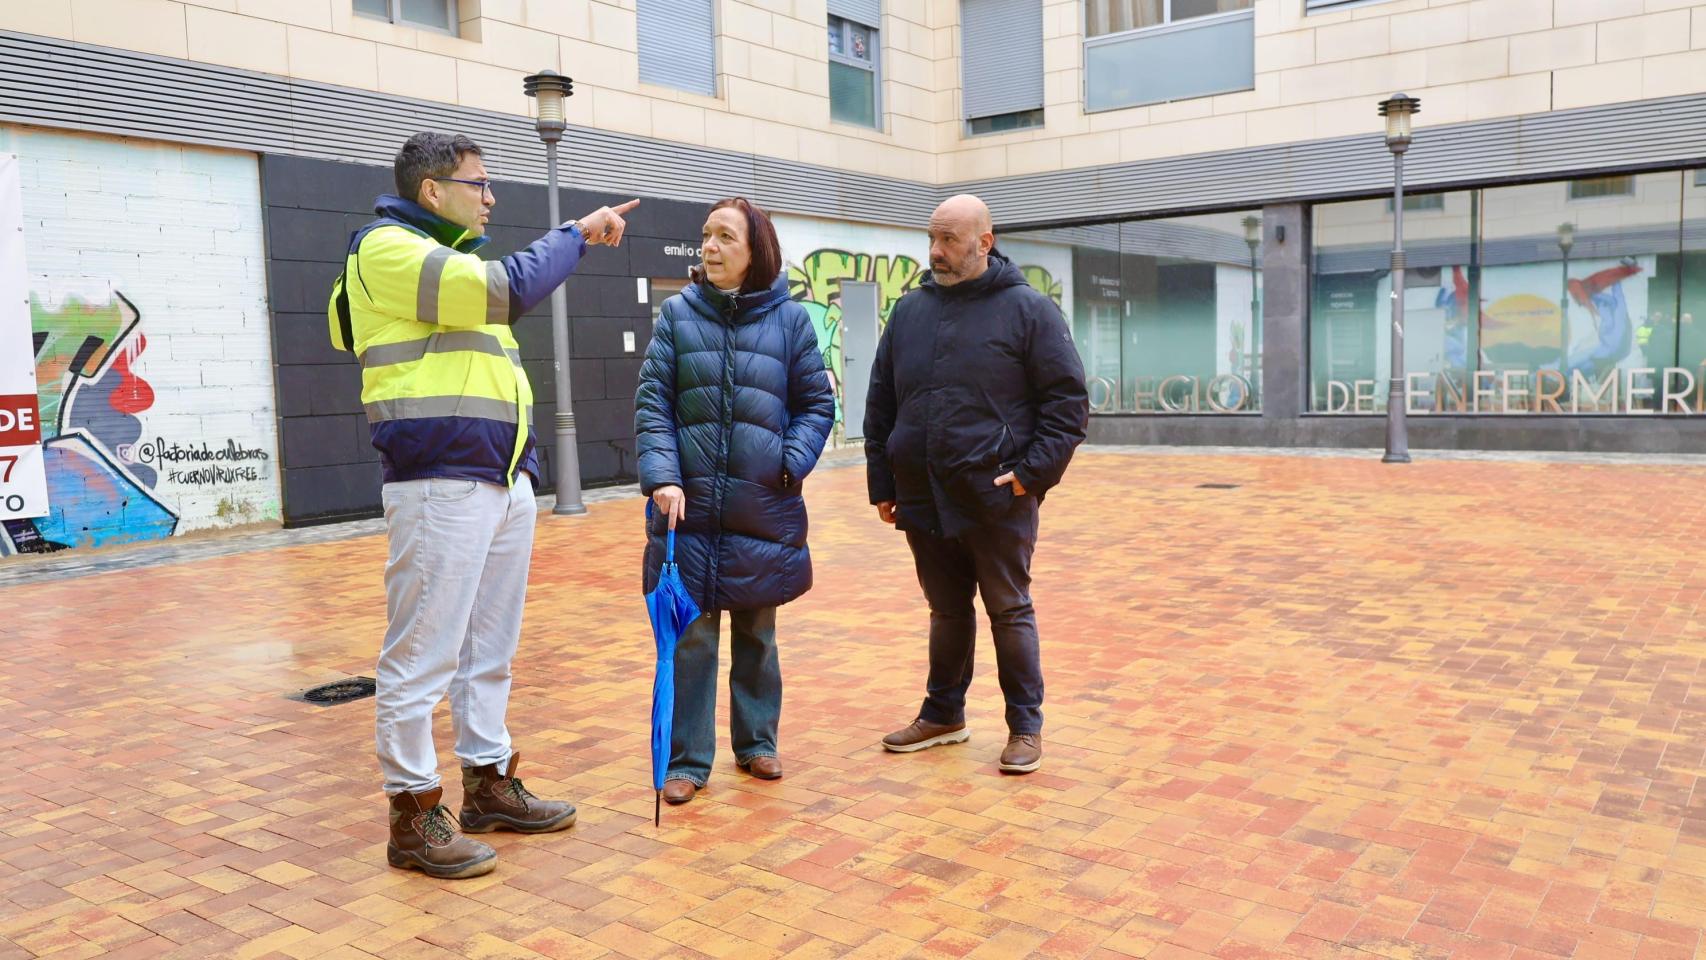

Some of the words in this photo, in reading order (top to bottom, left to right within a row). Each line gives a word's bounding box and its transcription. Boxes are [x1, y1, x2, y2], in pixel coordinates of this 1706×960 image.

[664, 242, 695, 257] emilio
[1087, 374, 1245, 413] OLEGIO
[1327, 379, 1375, 414] DE
[0, 494, 25, 512] O
